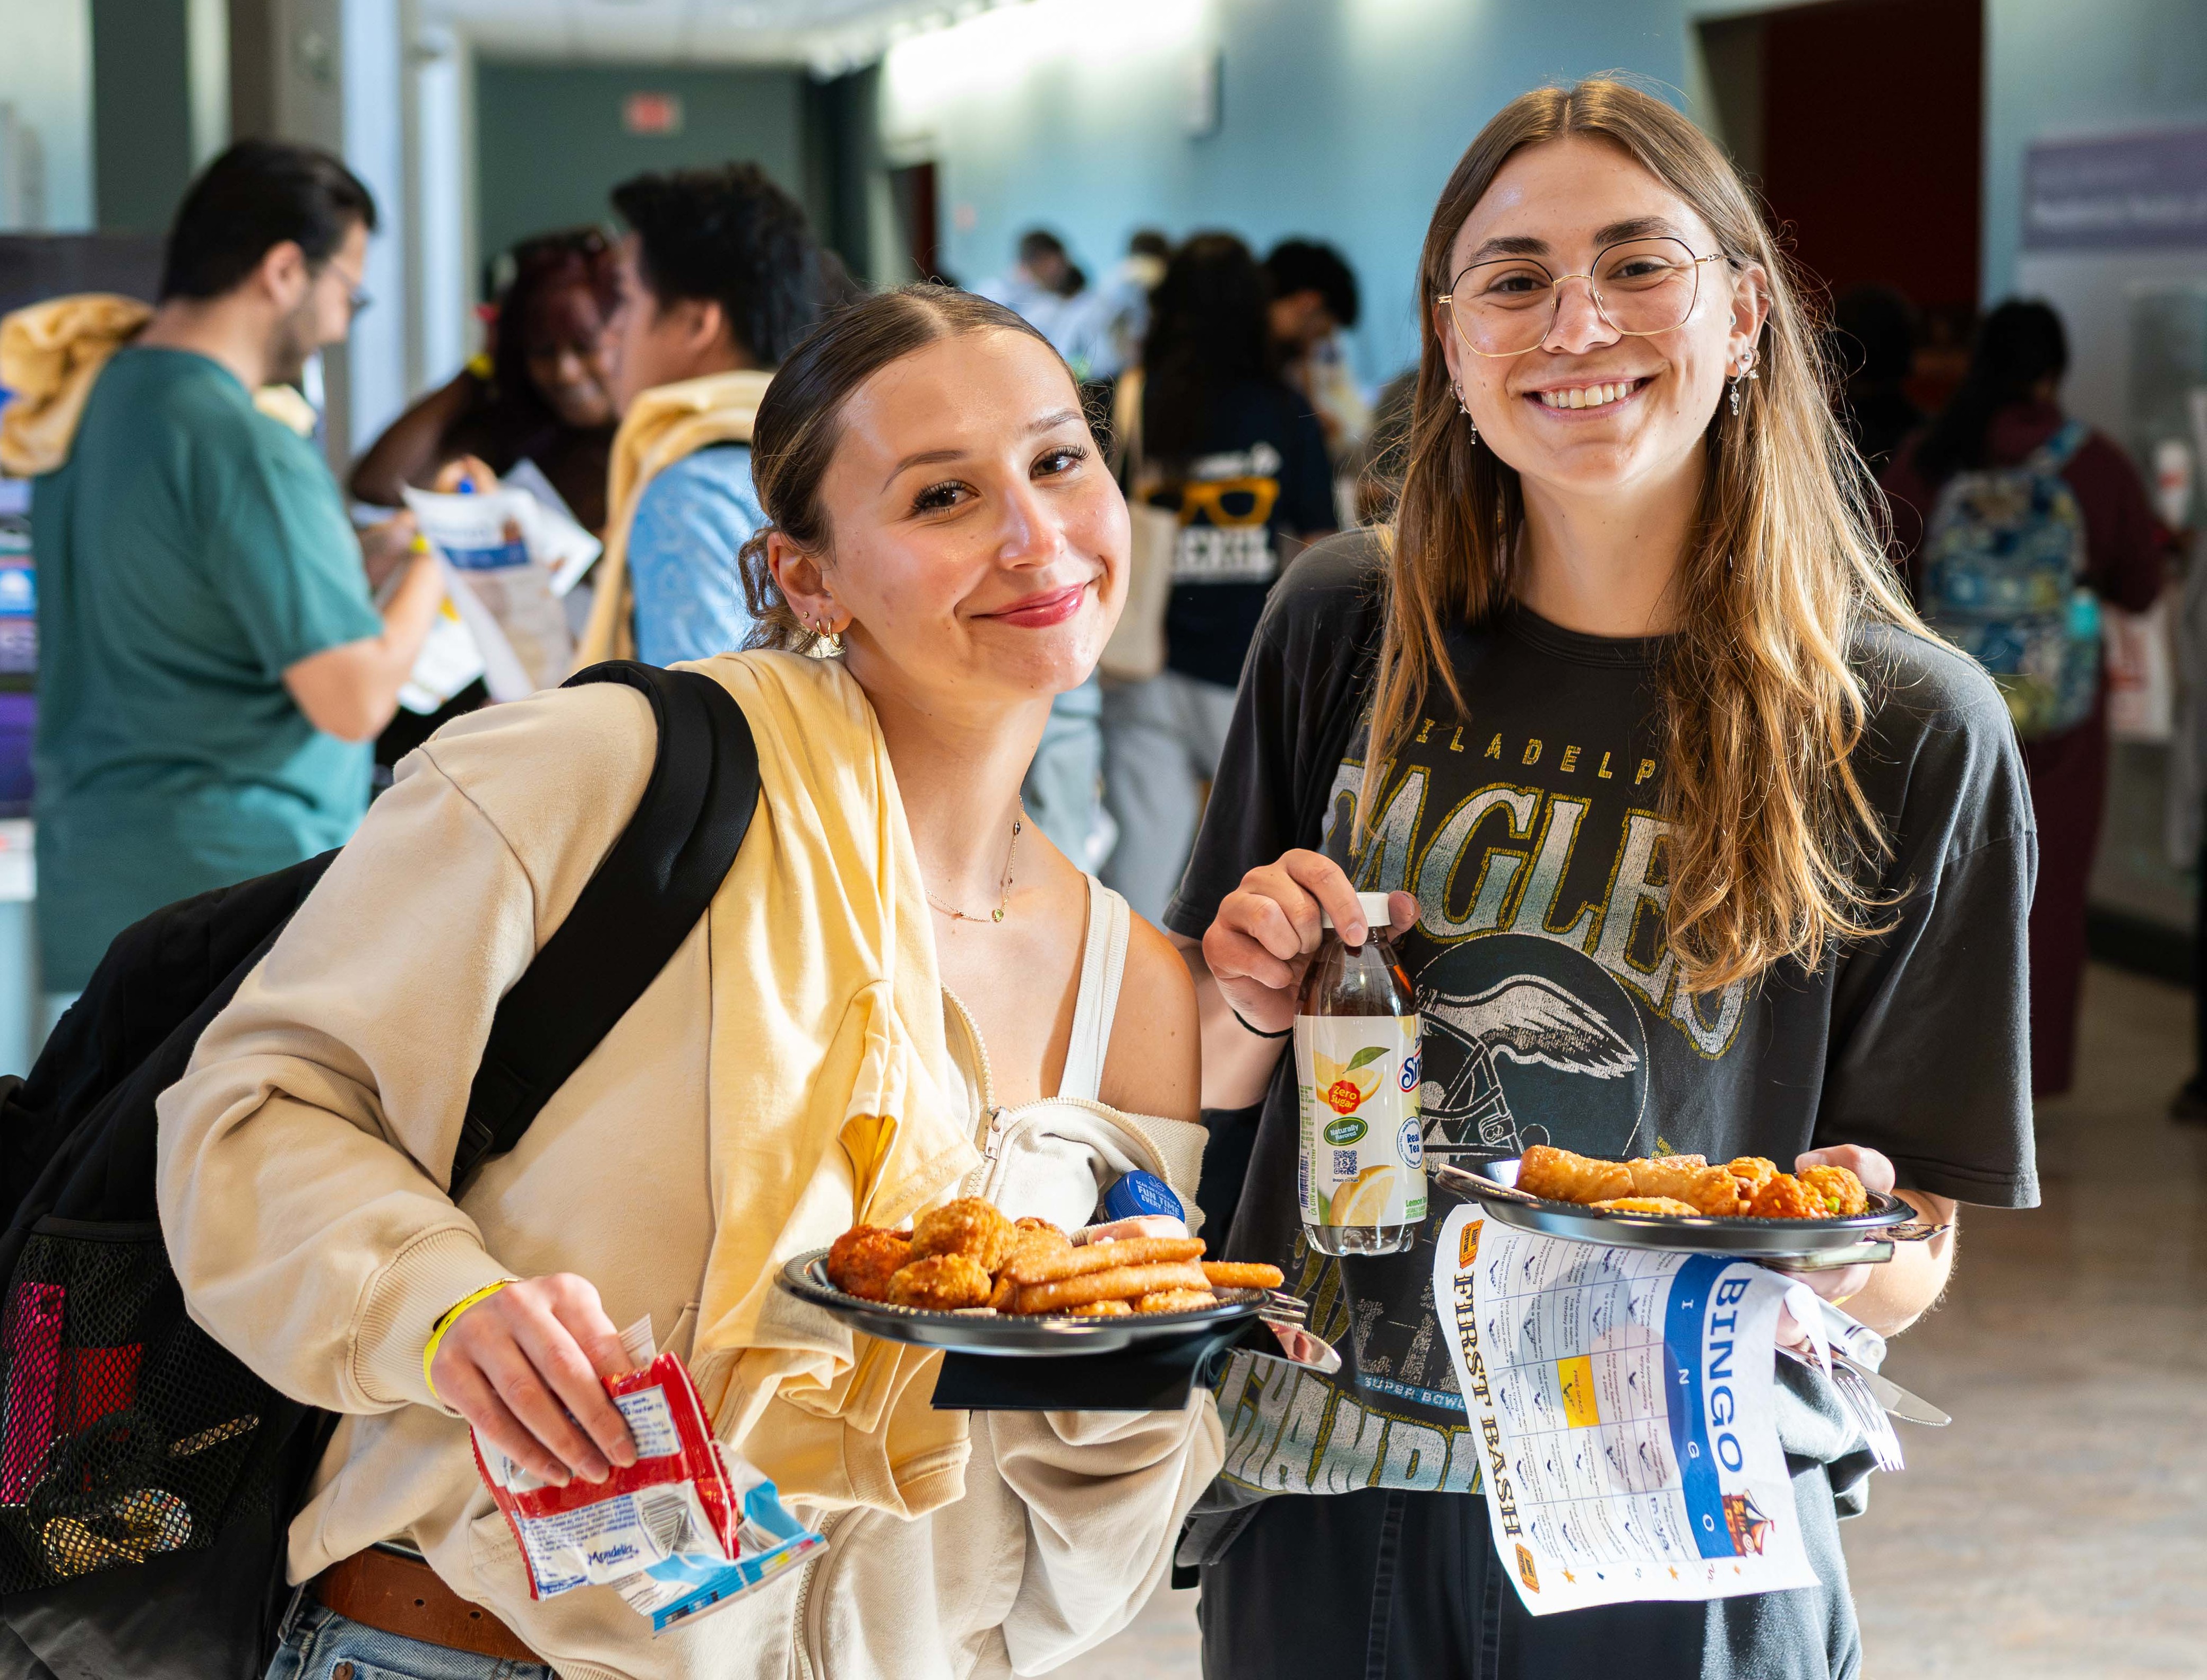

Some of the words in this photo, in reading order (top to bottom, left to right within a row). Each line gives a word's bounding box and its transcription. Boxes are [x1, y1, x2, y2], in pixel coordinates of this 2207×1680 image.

[1331, 1094, 1355, 1109] Sugar
[1333, 1085, 1357, 1100] Zero
[1330, 1123, 1359, 1136] Naturally
[1407, 1131, 1420, 1144] Real
[1409, 1144, 1420, 1154] Tea
[1137, 1185, 1157, 1200] FUN
[1159, 1196, 1180, 1215] TIME
[1141, 1194, 1162, 1209] EVERY
[1406, 1198, 1422, 1207] Lemon
[1499, 1244, 1510, 1271] different
[1539, 1239, 1550, 1258] enjoys
[1504, 1251, 1513, 1280] someone
[1541, 1246, 1553, 1275] someone
[1532, 1260, 1541, 1285] reading
[1681, 1299, 1694, 1310] I
[1678, 1369, 1690, 1384] N
[1709, 1278, 1752, 1472] BINGO
[1364, 1376, 1415, 1399] SUPER
[1421, 1391, 1465, 1410] BOWL
[1516, 1385, 1525, 1416] someone
[1454, 1270, 1493, 1407] FIRST
[1480, 1415, 1524, 1538] BASH
[1687, 1441, 1700, 1459] G
[1530, 1454, 1539, 1485] someone
[1557, 1451, 1567, 1482] someone
[1702, 1513, 1714, 1532] O
